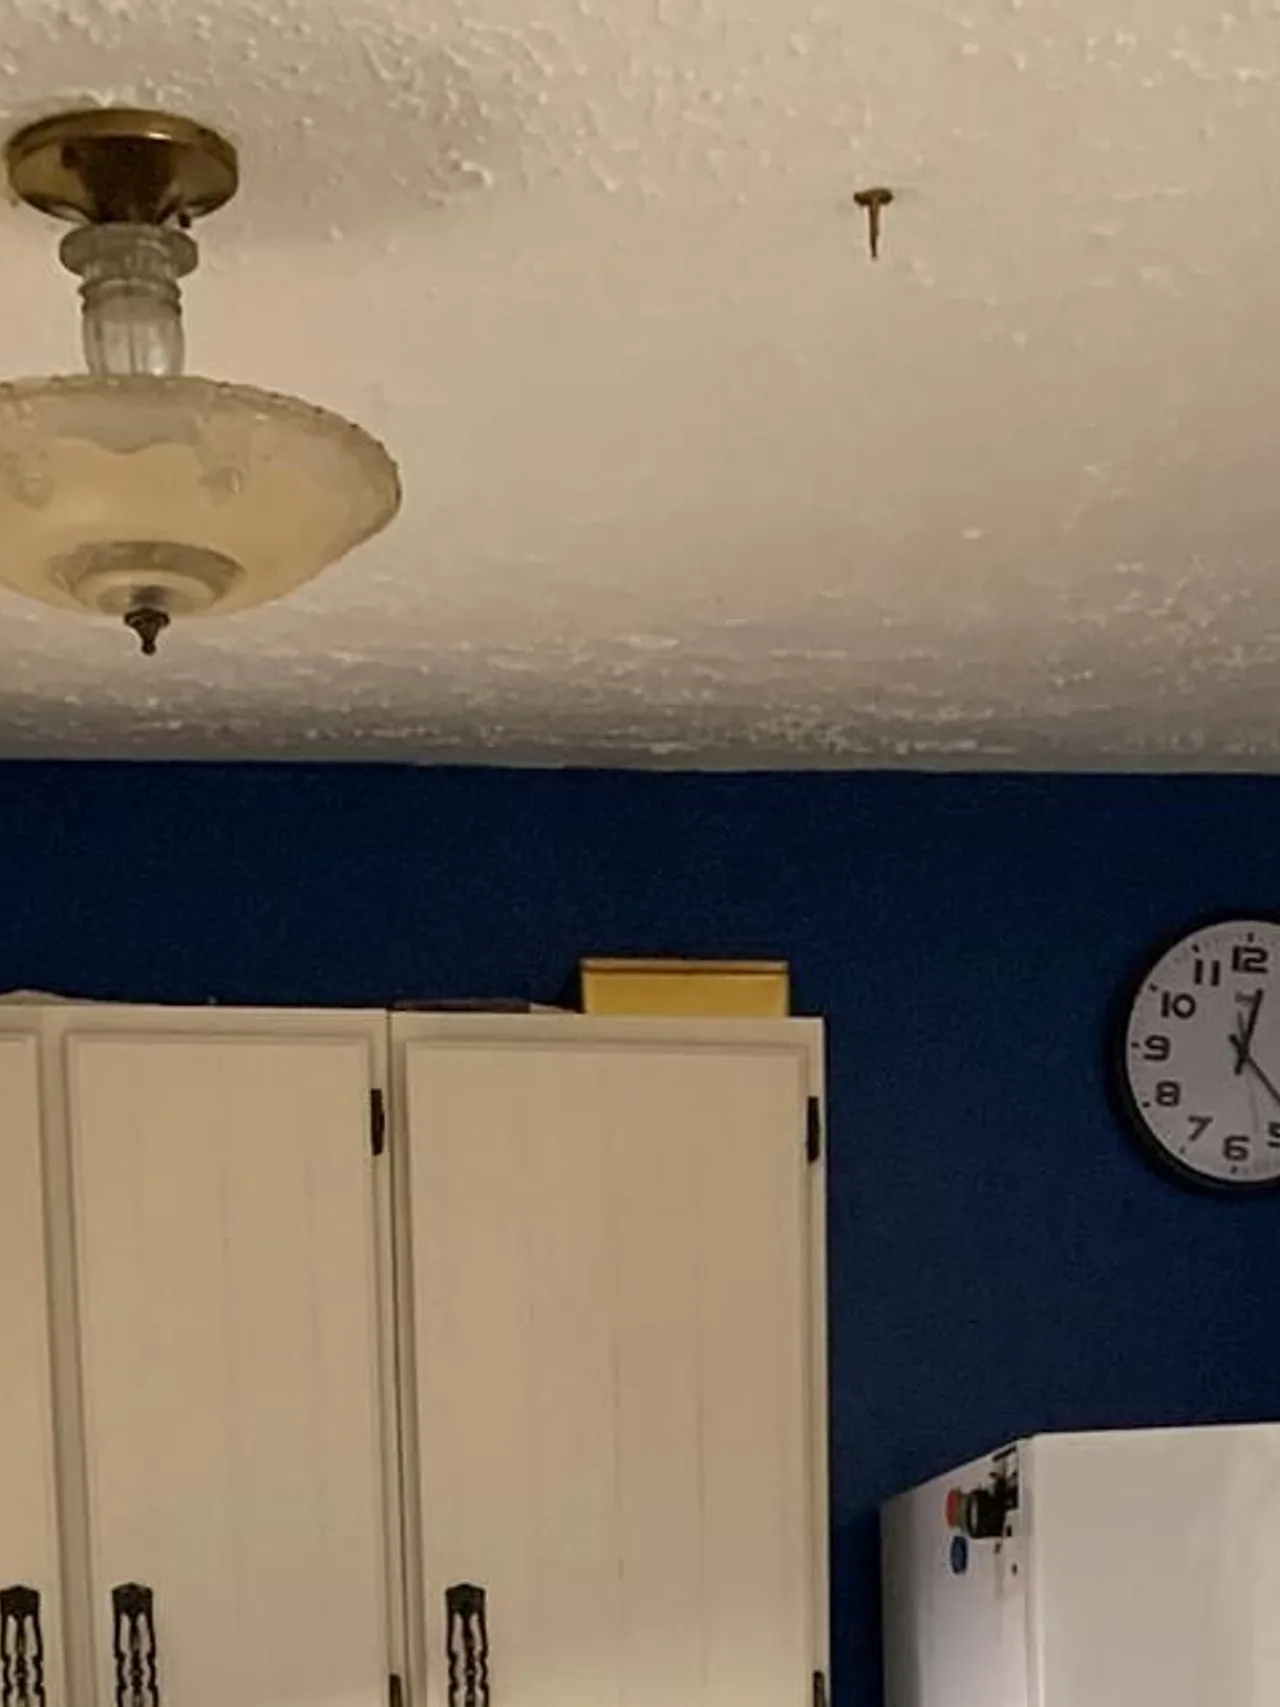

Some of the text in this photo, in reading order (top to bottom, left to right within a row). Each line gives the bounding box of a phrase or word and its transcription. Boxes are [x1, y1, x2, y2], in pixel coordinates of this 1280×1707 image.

[1194, 959, 1221, 987] 11
[1232, 946, 1268, 974] 12
[1160, 991, 1197, 1019] 10
[1144, 1035, 1171, 1062] 9
[1155, 1081, 1181, 1107] 8
[1187, 1115, 1213, 1142] 7
[1223, 1135, 1250, 1161] 6
